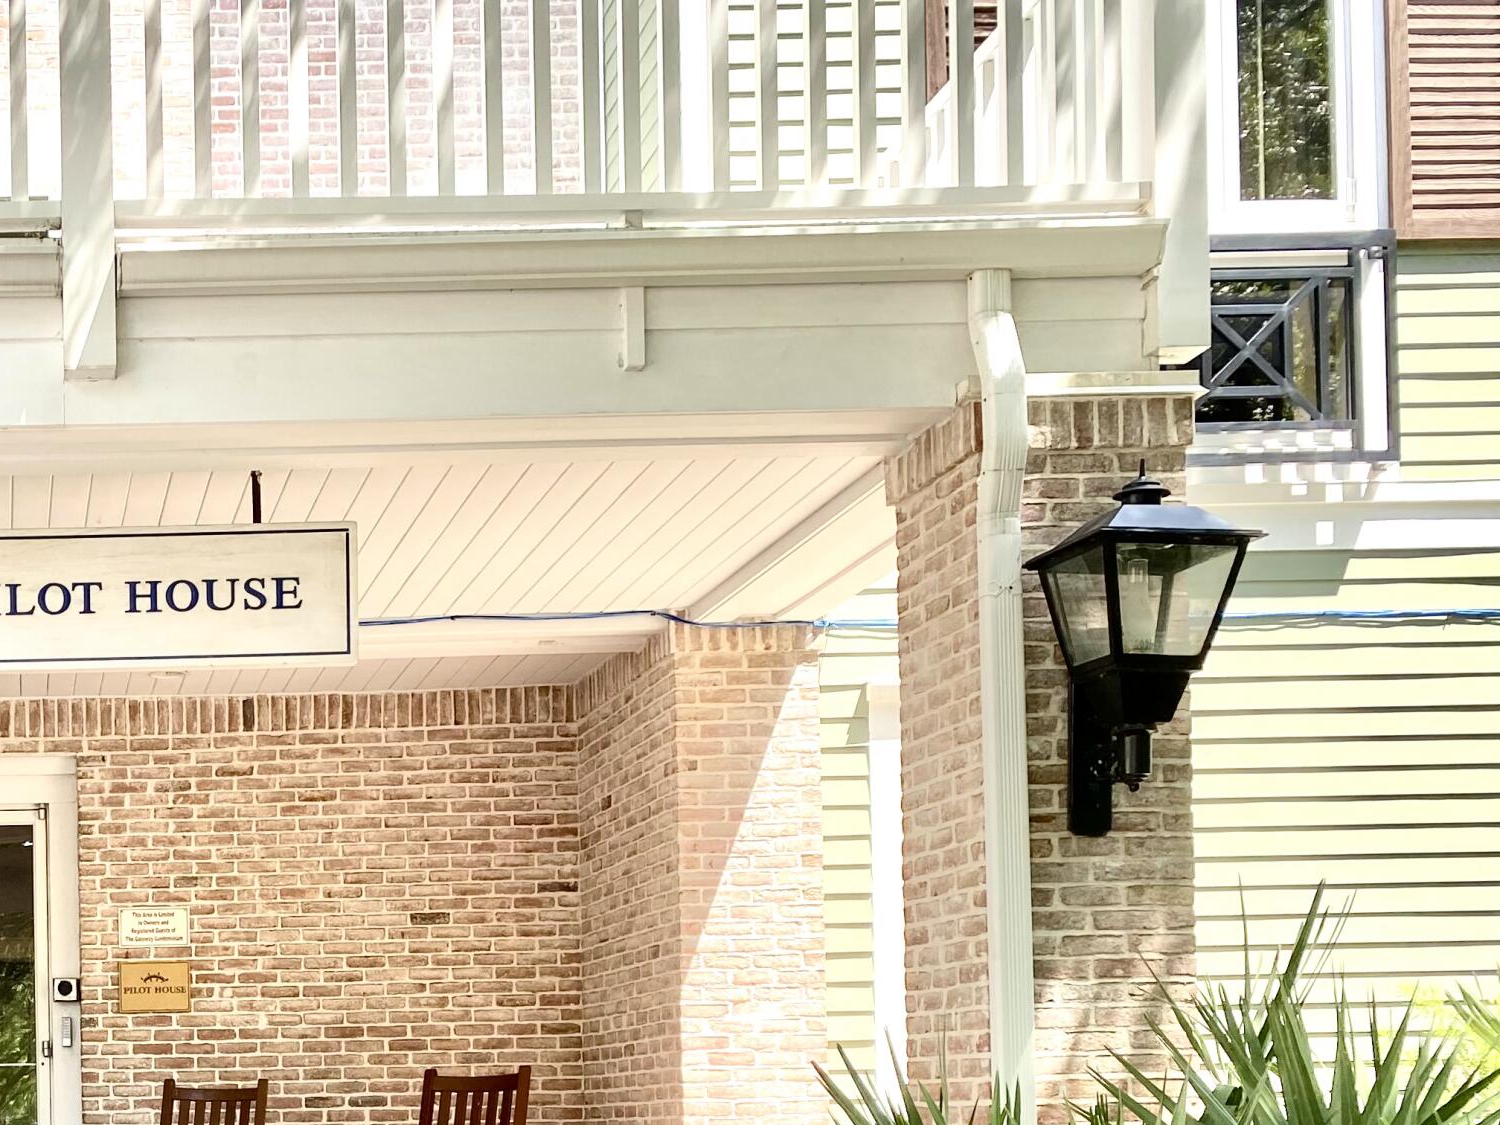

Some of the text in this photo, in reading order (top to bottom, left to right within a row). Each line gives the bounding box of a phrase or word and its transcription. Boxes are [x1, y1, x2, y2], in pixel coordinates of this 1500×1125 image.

[124, 576, 304, 613] HOUSE
[123, 986, 187, 995] PILOT HOUSE
